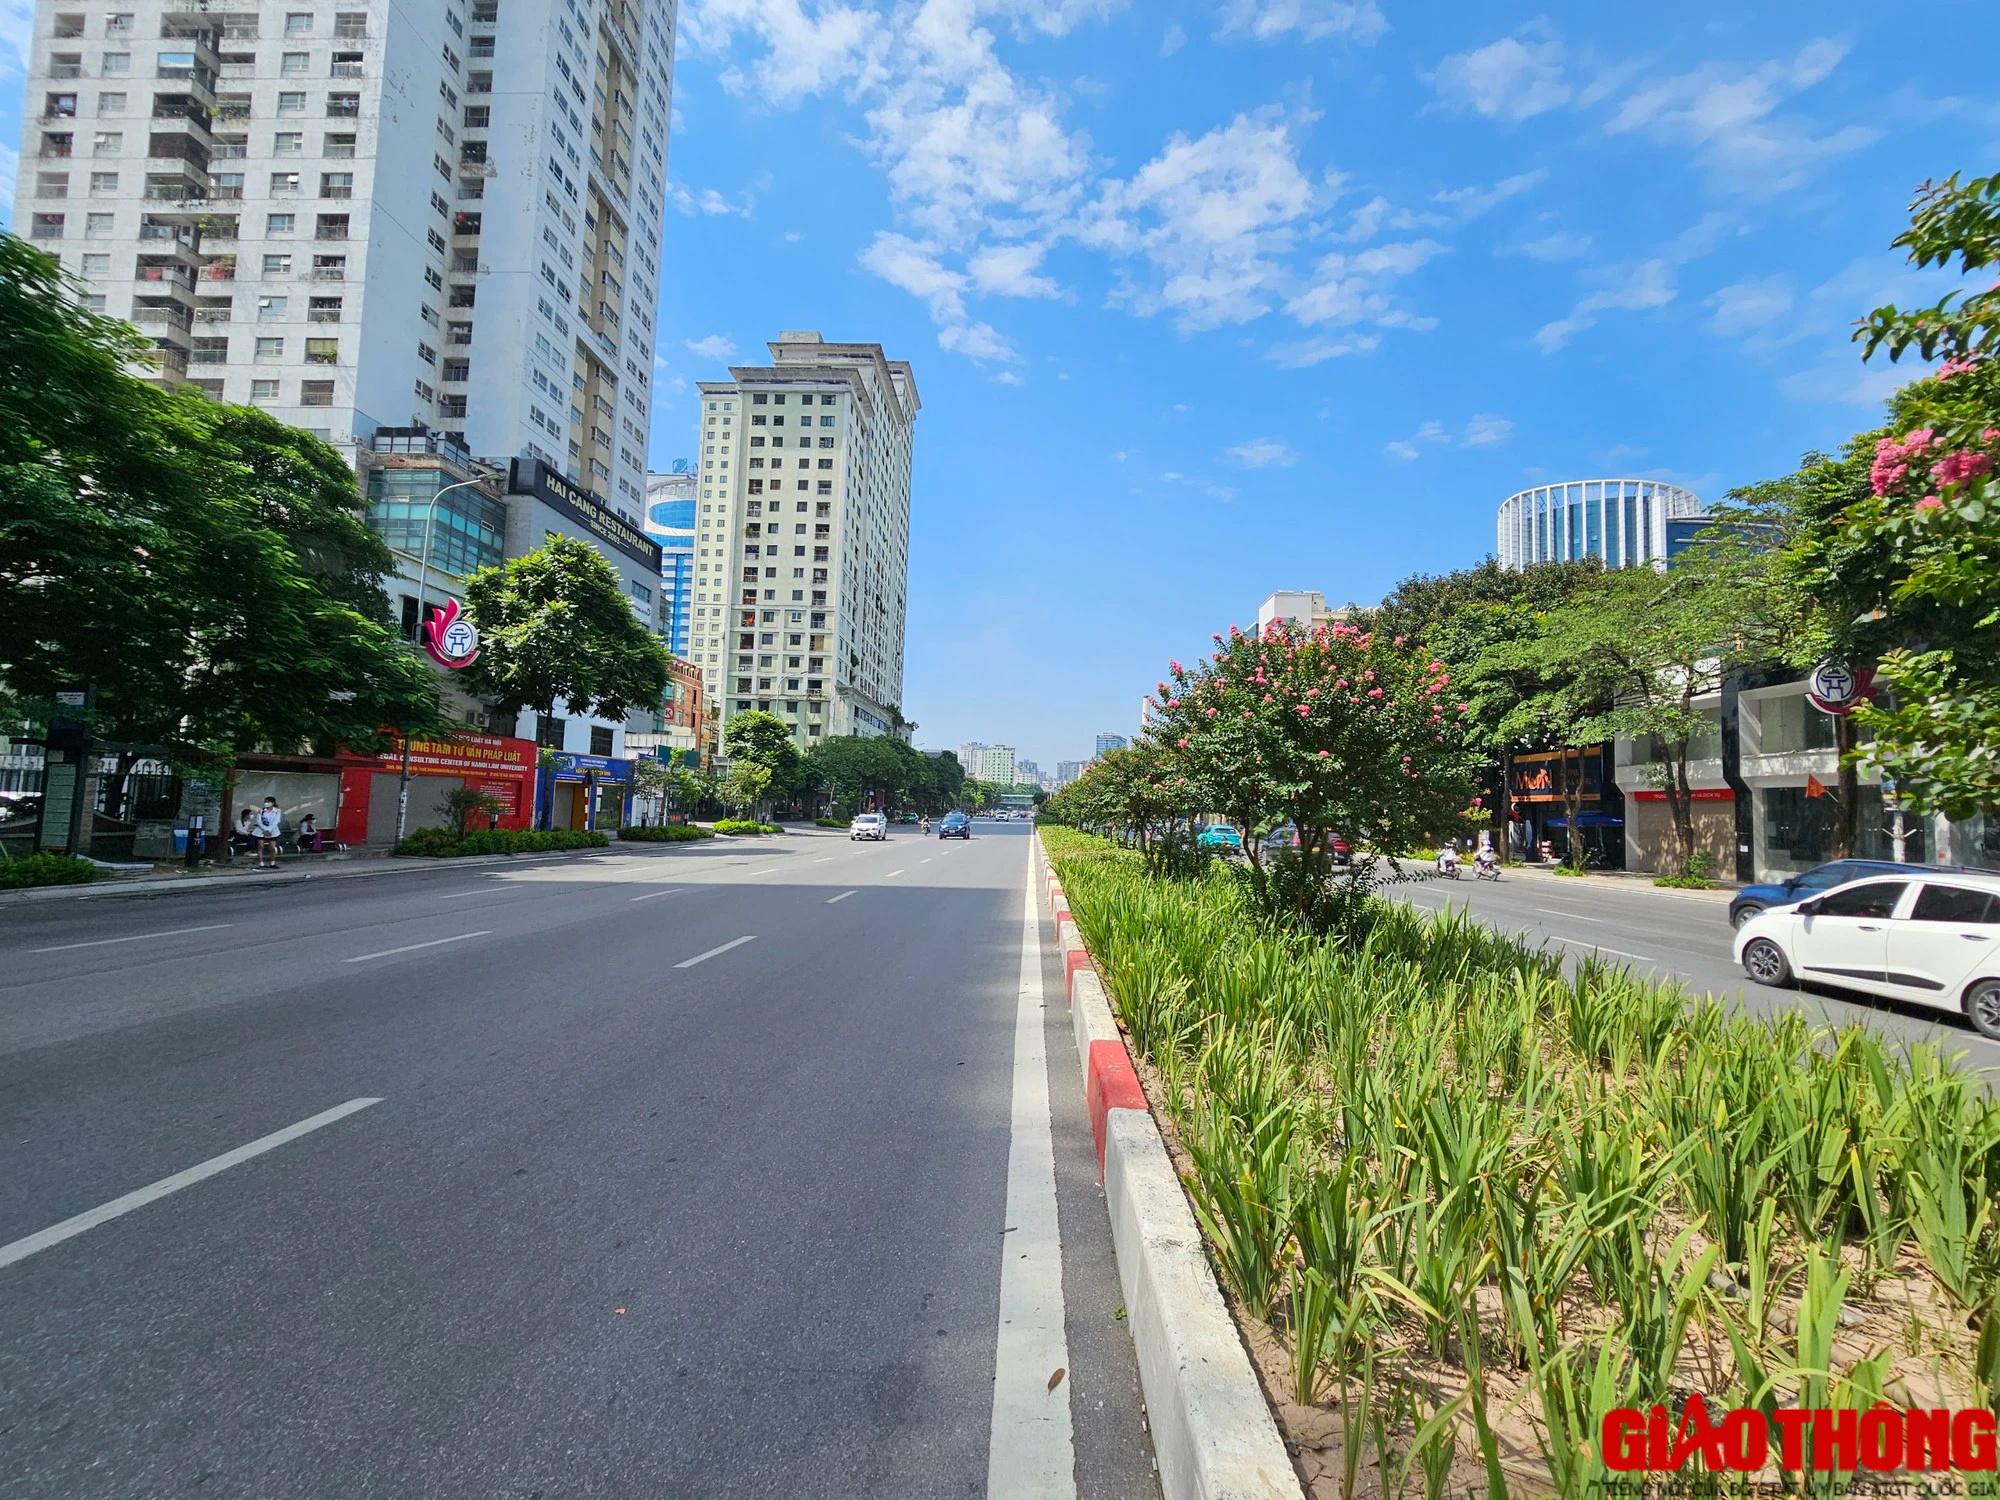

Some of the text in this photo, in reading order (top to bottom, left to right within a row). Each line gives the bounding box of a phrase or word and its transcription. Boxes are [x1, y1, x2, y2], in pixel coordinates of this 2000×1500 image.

[546, 474, 654, 557] HAI CANG RESTAURANT
[589, 520, 607, 537] SINCE
[376, 753, 398, 761] EGAL
[399, 755, 440, 764] CNSULTING
[440, 758, 463, 767] CENTER
[470, 761, 488, 769] HANOI
[500, 764, 528, 772] UNIVERSITY
[397, 739, 430, 753] TUNG
[482, 749, 503, 761] PHÁP
[504, 750, 521, 764] LUẬT
